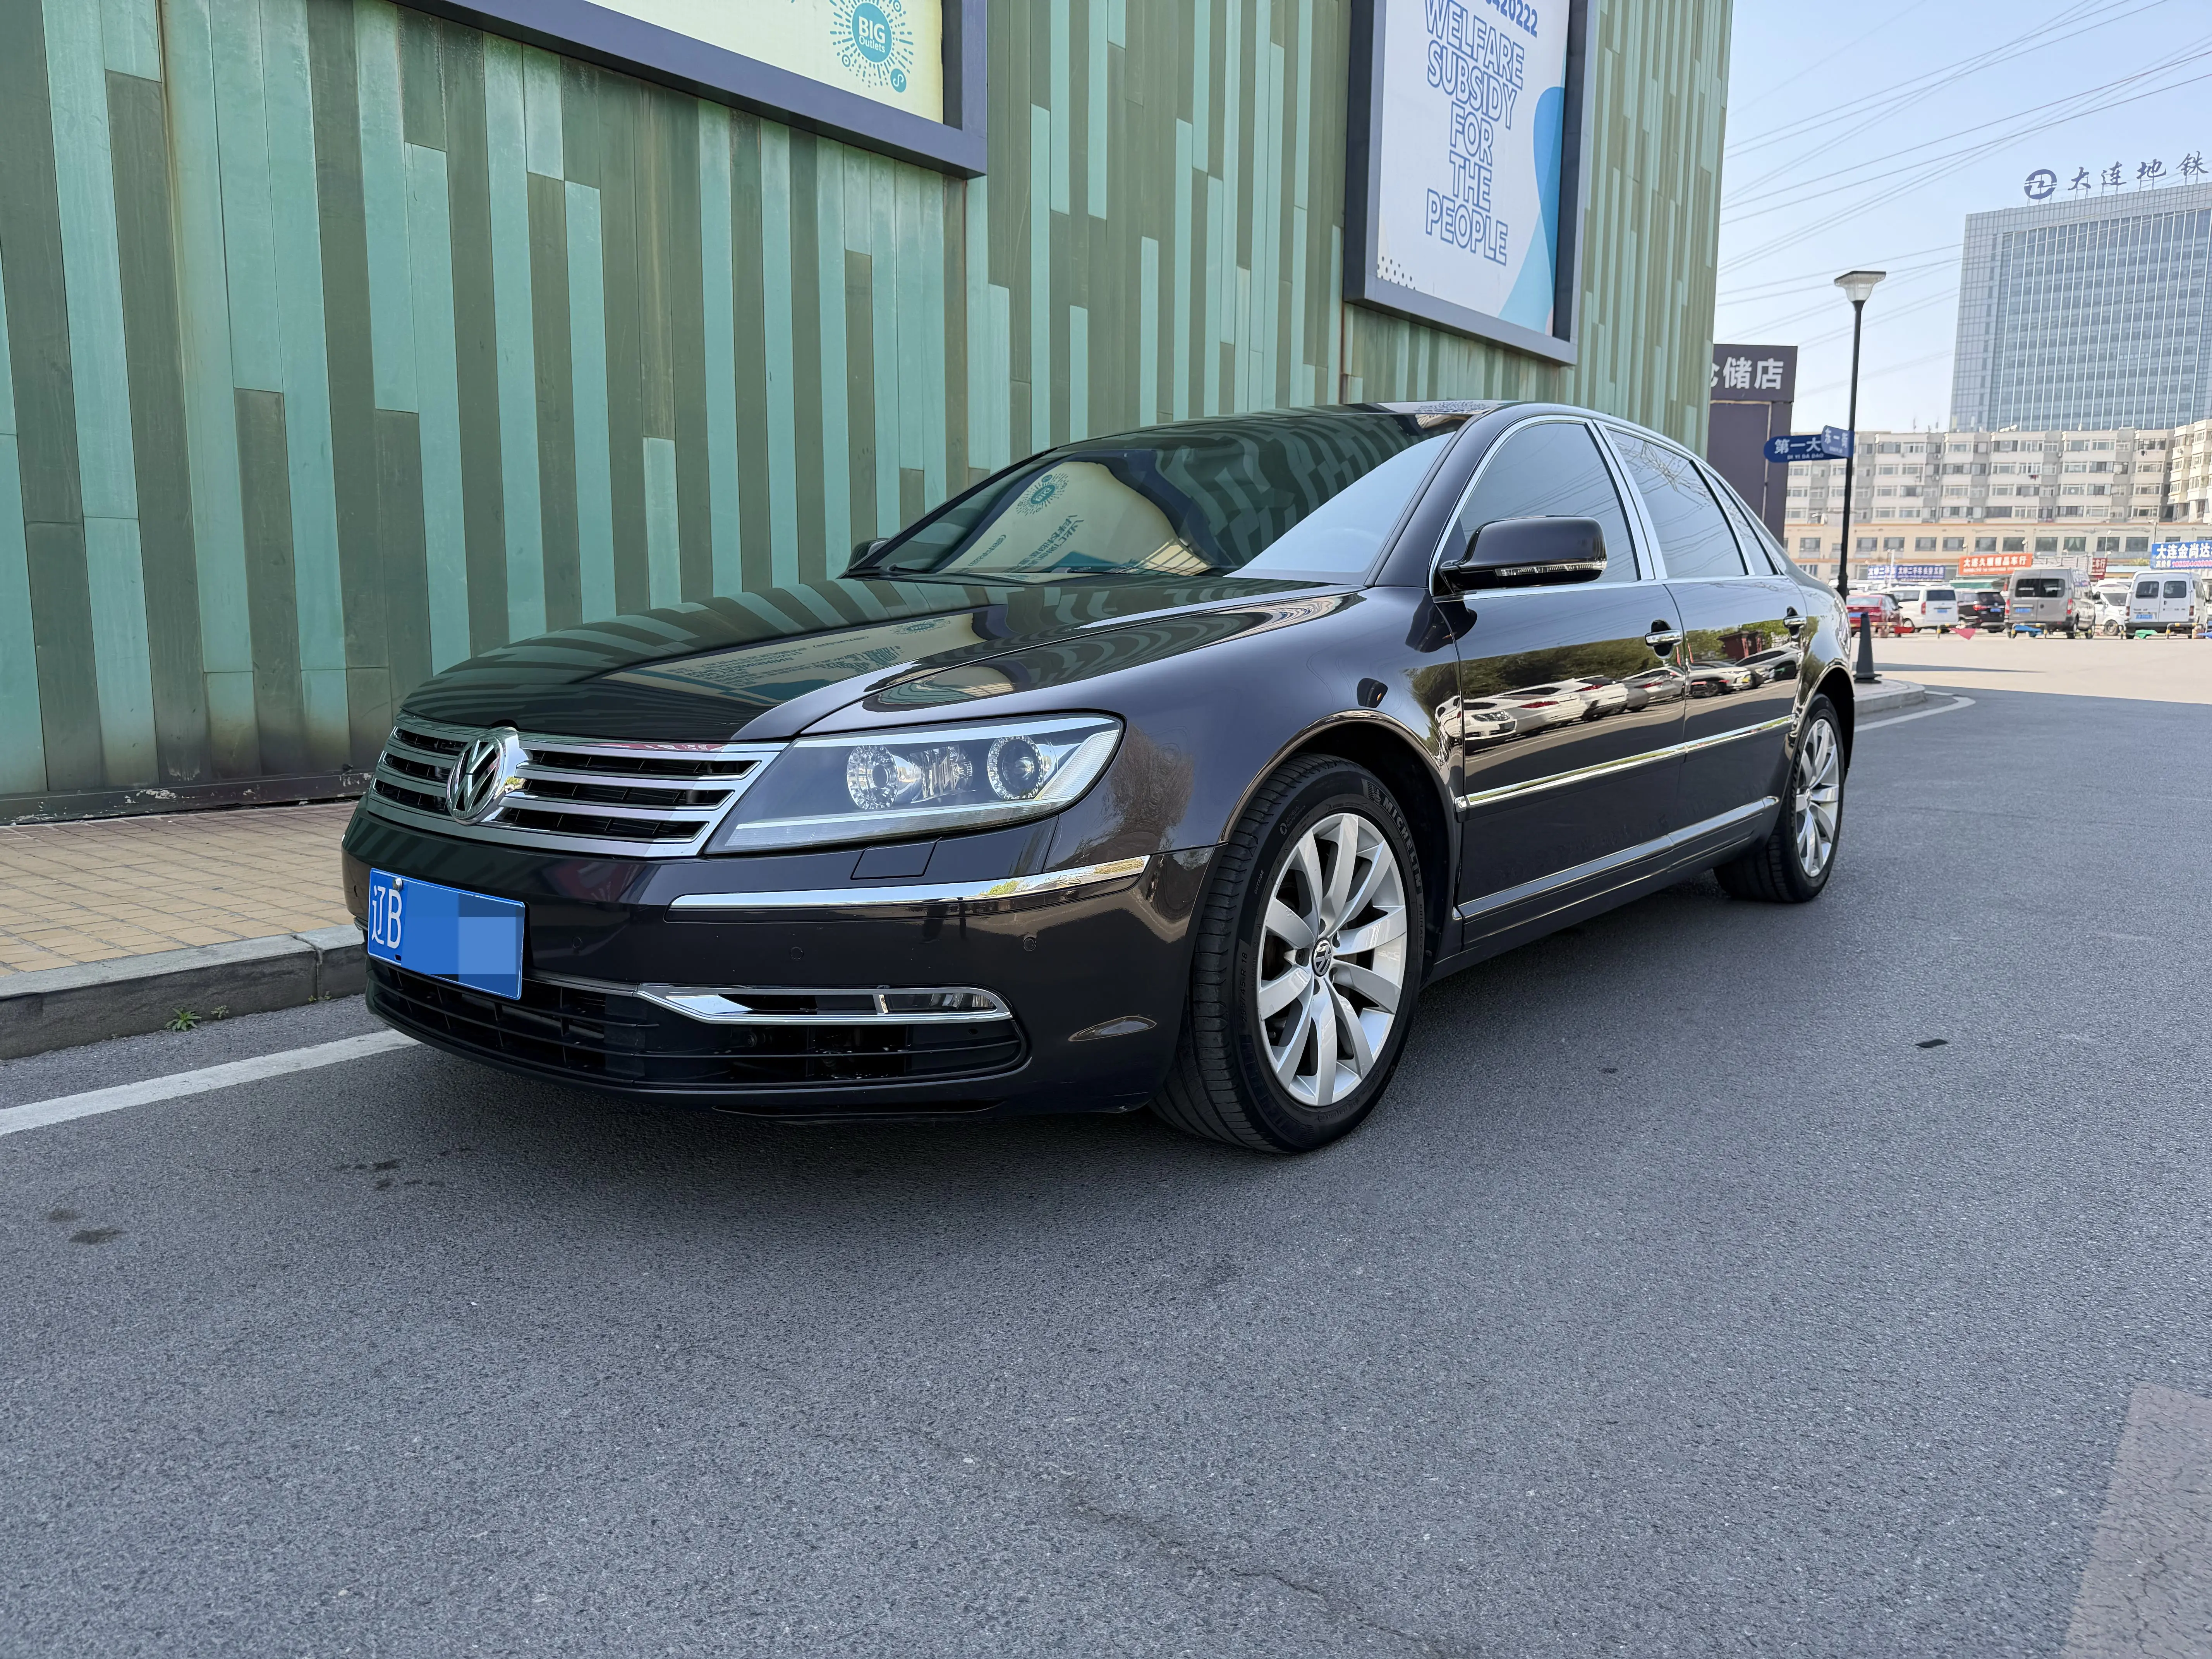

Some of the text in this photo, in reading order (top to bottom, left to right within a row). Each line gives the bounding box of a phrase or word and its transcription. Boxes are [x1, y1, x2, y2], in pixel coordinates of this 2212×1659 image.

[859, 16, 885, 44] BIG
[859, 36, 885, 53] Outlets
[1424, 0, 1525, 90] WELFARE
[1427, 40, 1517, 131] SUBSIDY
[1449, 101, 1494, 167] FOR
[1449, 149, 1492, 213] THE
[2068, 150, 2209, 191] 大连地铁
[1425, 188, 1508, 266] PEOPLE
[2156, 542, 2212, 560] 大连金尚达
[1382, 797, 1422, 888] MICHELIN
[1254, 869, 1264, 895] OUTSIDE
[1241, 952, 1248, 964] 18
